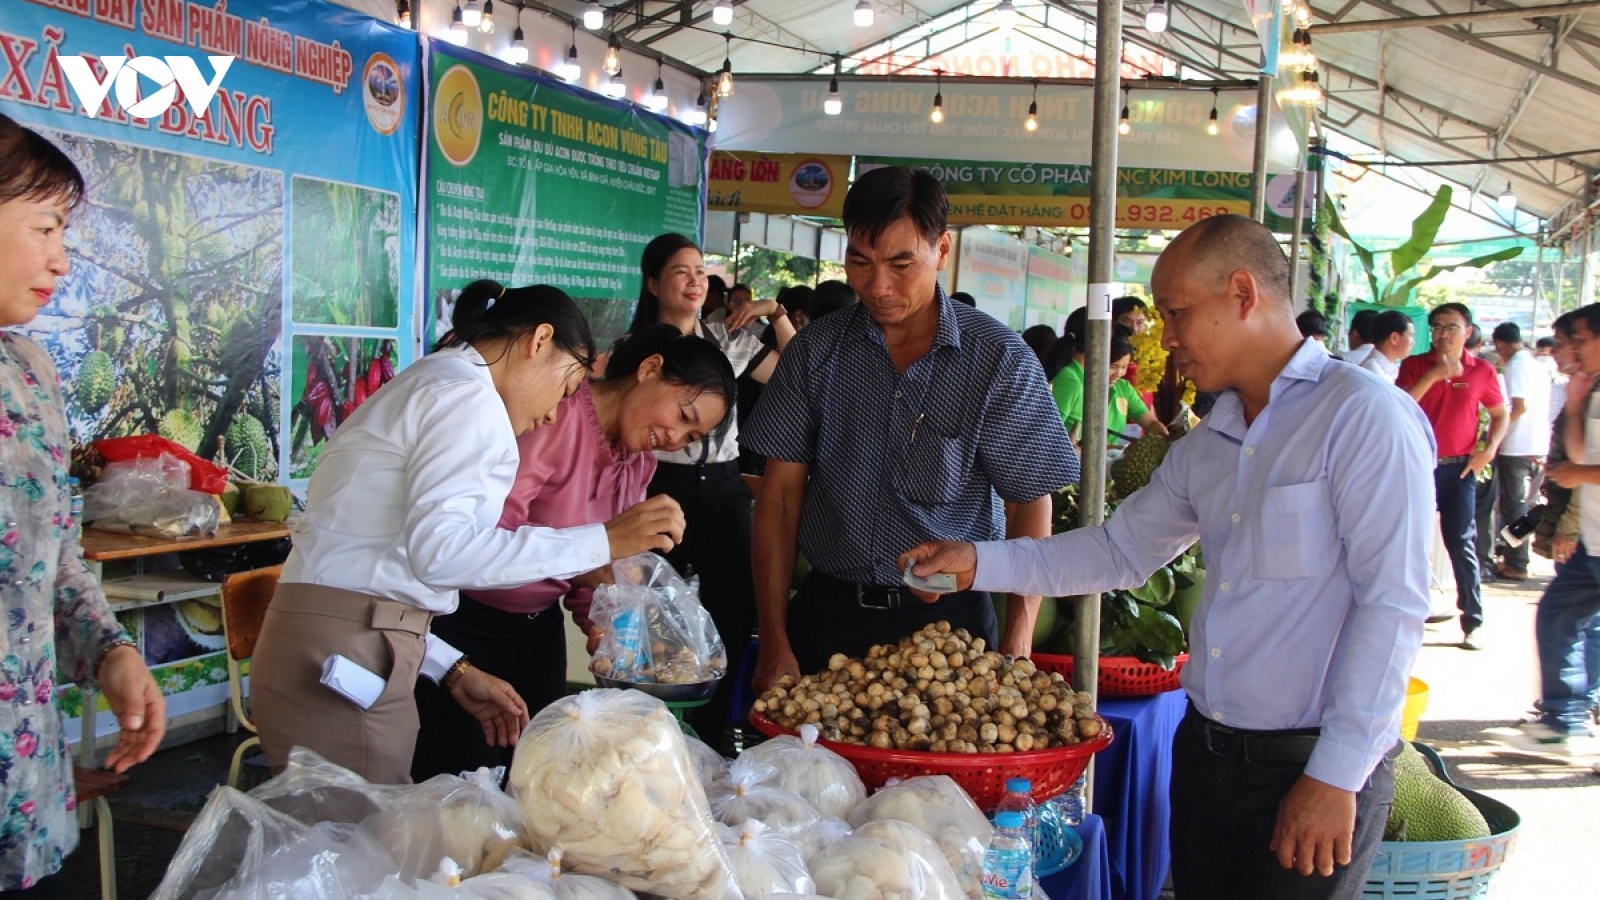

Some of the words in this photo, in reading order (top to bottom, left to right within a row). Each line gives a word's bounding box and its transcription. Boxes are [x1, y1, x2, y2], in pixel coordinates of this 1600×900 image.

[0, 25, 73, 113] XÃ
[245, 19, 293, 74] NÔNG
[294, 34, 353, 94] NGHIỆP
[487, 89, 528, 128] CÔNG
[531, 103, 548, 132] TY
[551, 109, 584, 142] TNHH
[587, 120, 618, 150] ACON
[620, 127, 648, 160] VŨNG
[649, 134, 668, 164] TÀU
[498, 129, 513, 146] SẢN
[978, 167, 1004, 183] TY
[1007, 163, 1037, 184] CỔ
[1150, 170, 1189, 186] KIM
[1191, 172, 1250, 188] LONG
[1020, 203, 1066, 218] HÀNG:
